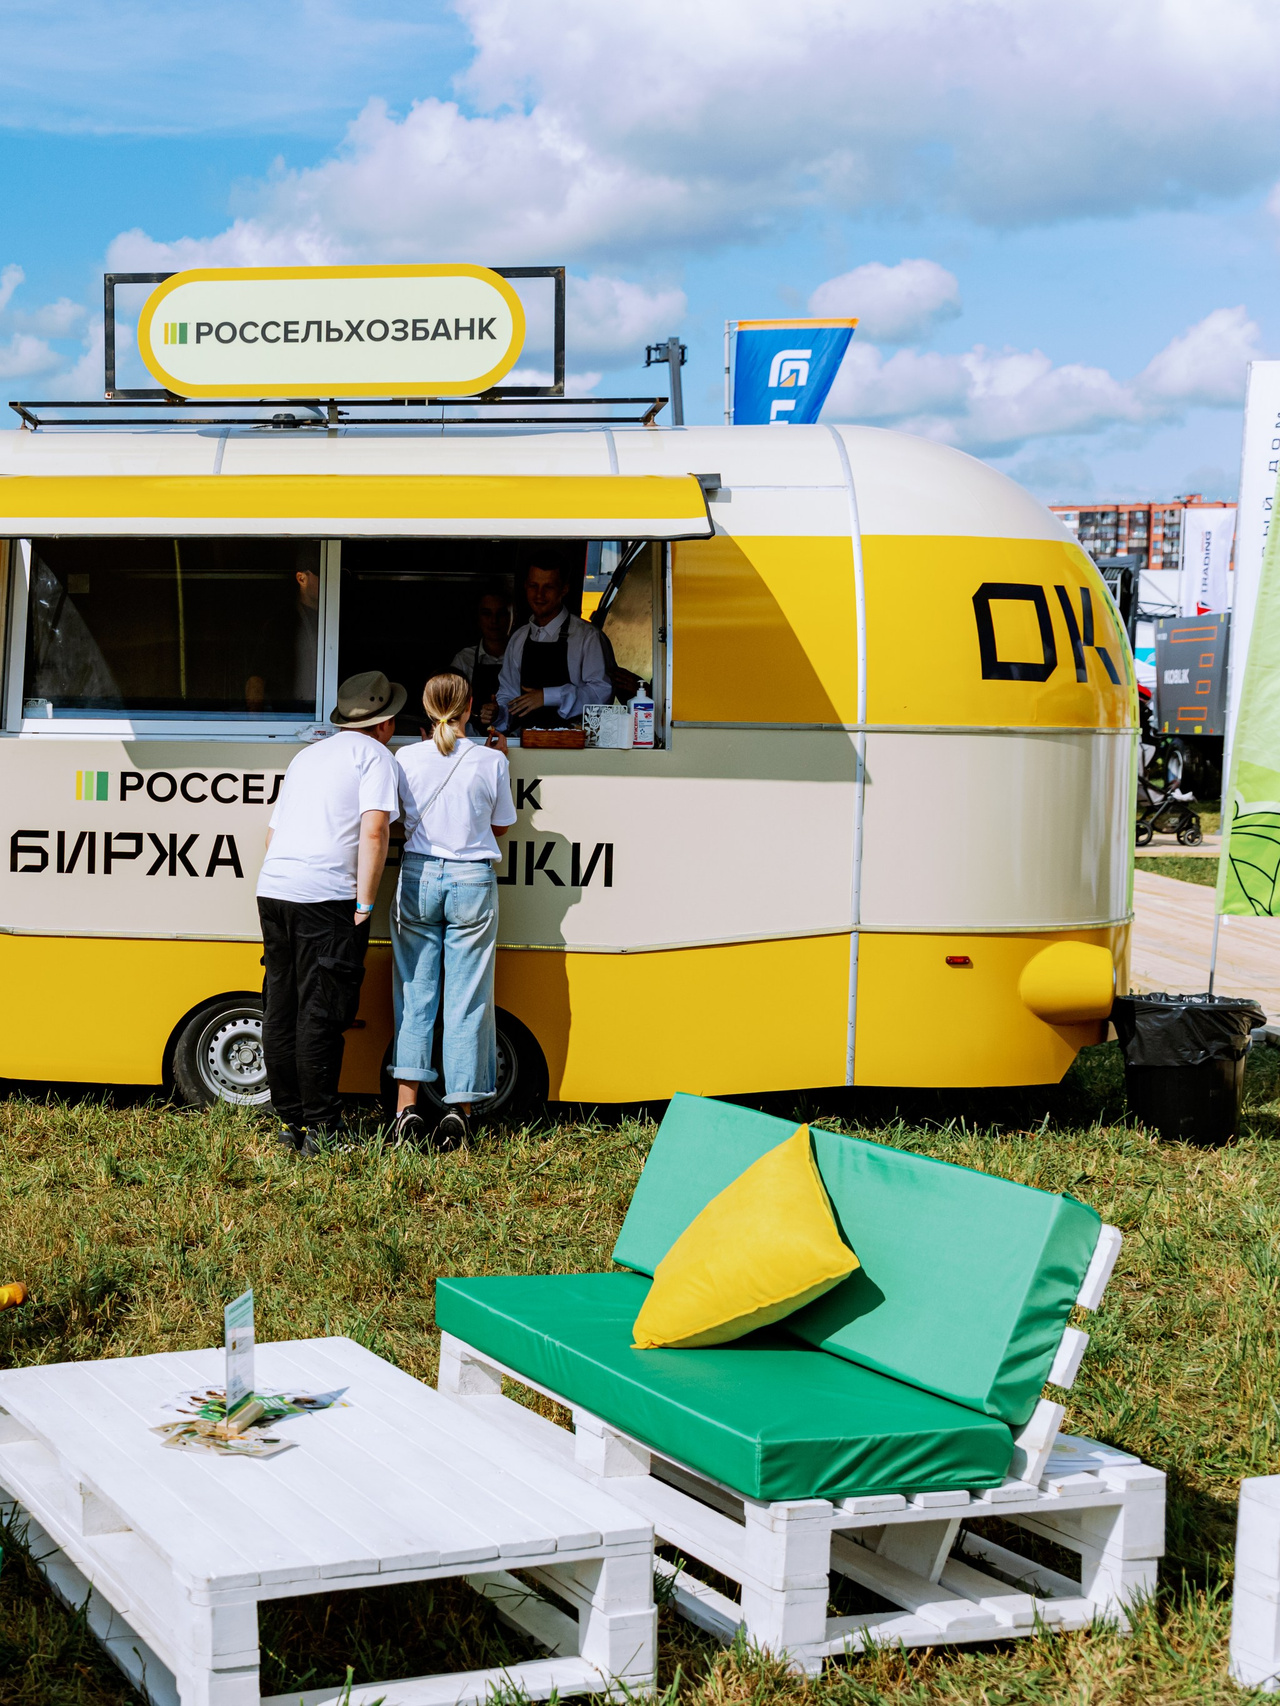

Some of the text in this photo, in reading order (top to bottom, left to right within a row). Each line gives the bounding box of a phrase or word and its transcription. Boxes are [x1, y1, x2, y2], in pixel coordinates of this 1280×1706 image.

[195, 316, 497, 345] РОССЕЛЬХОЗБАНК
[1201, 531, 1213, 593] TRADING
[10, 829, 245, 879] БИРЖА
